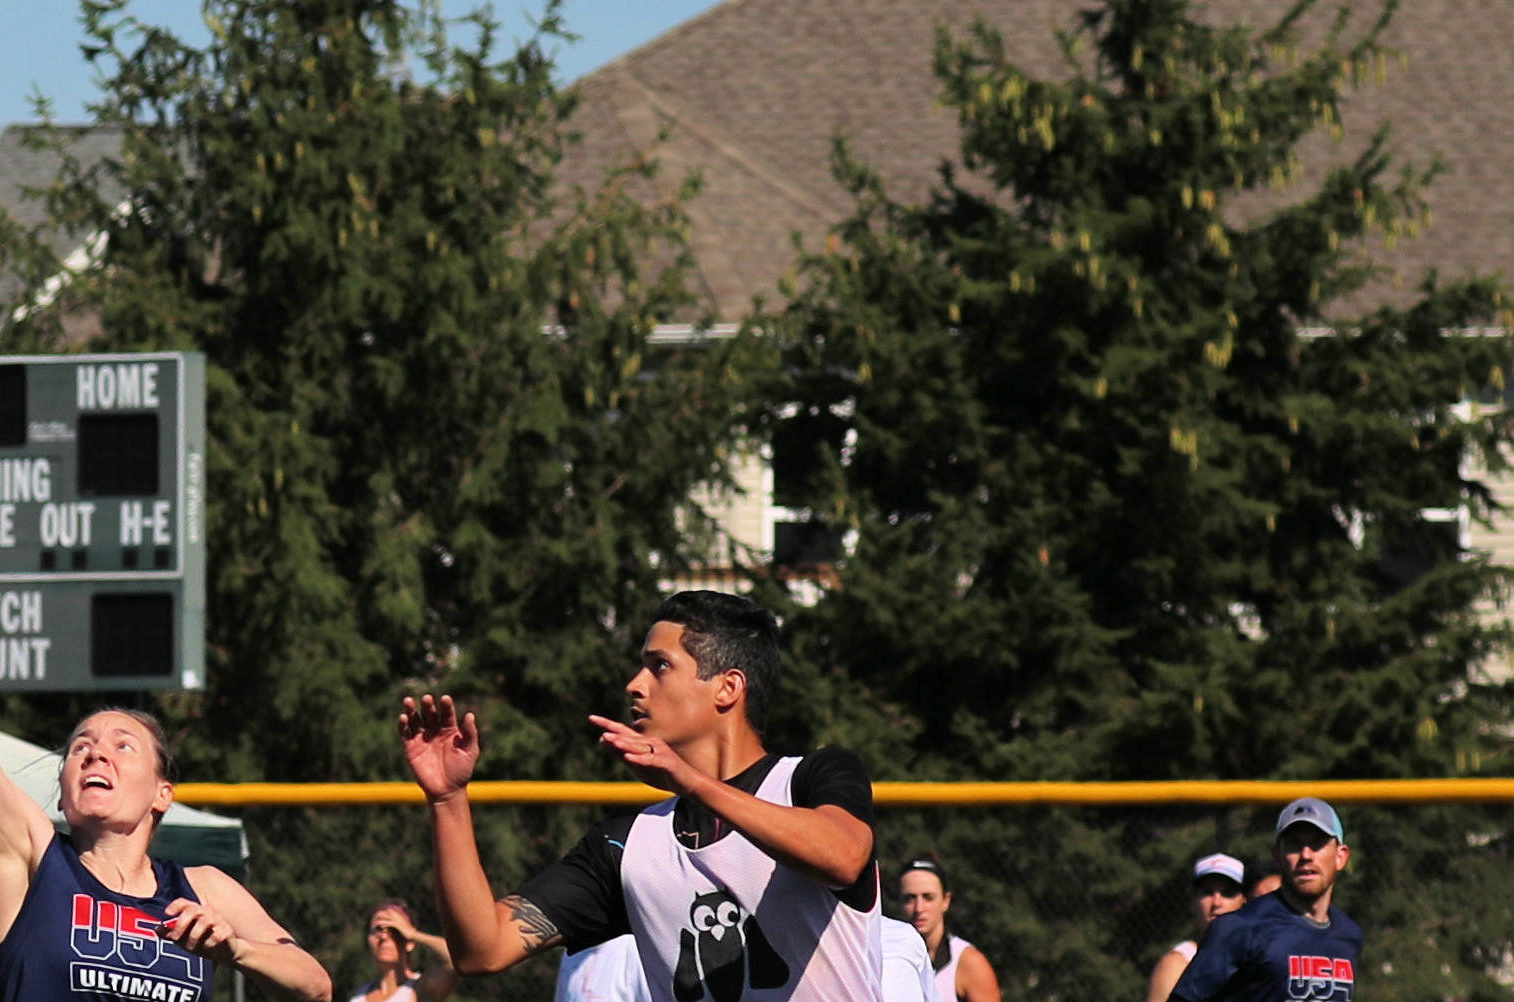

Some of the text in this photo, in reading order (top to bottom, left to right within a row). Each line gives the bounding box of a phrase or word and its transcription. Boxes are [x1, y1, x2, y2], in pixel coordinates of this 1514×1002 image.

[77, 363, 160, 410] HOME
[40, 502, 96, 548] OUT
[120, 500, 171, 545] H-E
[1288, 955, 1355, 1002] USA
